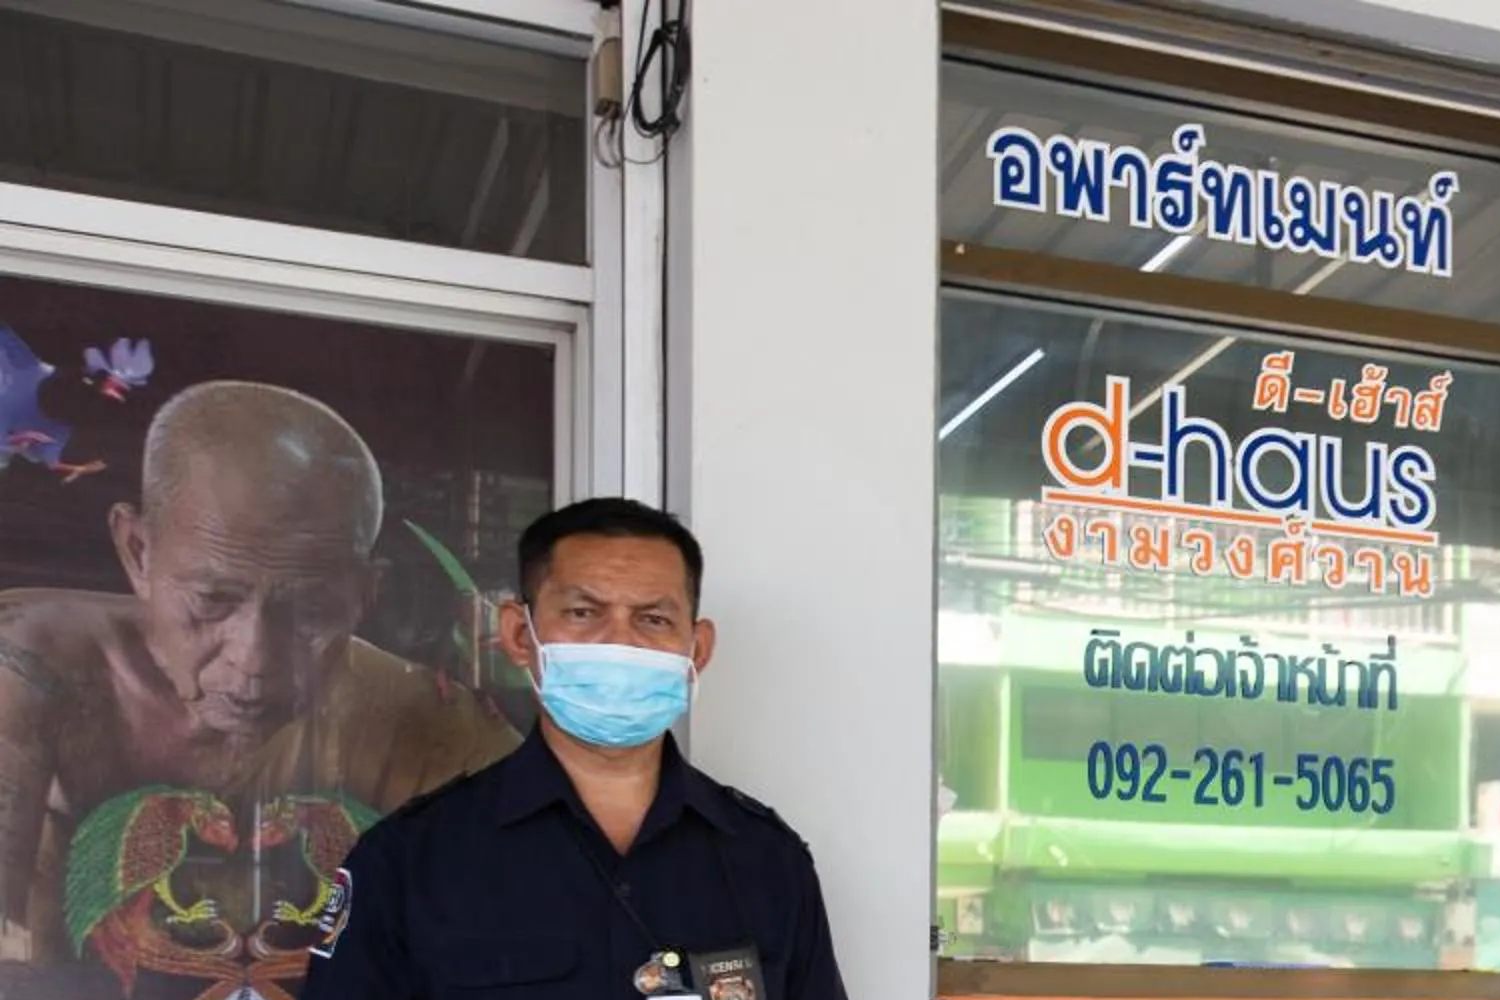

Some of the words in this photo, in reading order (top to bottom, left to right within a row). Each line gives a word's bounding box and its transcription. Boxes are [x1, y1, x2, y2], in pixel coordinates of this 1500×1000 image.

[987, 124, 1459, 277] อพาร์ทเมนท์
[1253, 351, 1453, 432] ดี-เฮ้าส์
[1042, 375, 1437, 530] d-haus
[1044, 514, 1436, 598] งามวงศ์วาน
[1084, 629, 1397, 710] ติดต่อเจ้าหน้าที่
[1087, 740, 1396, 815] 092-261-5065
